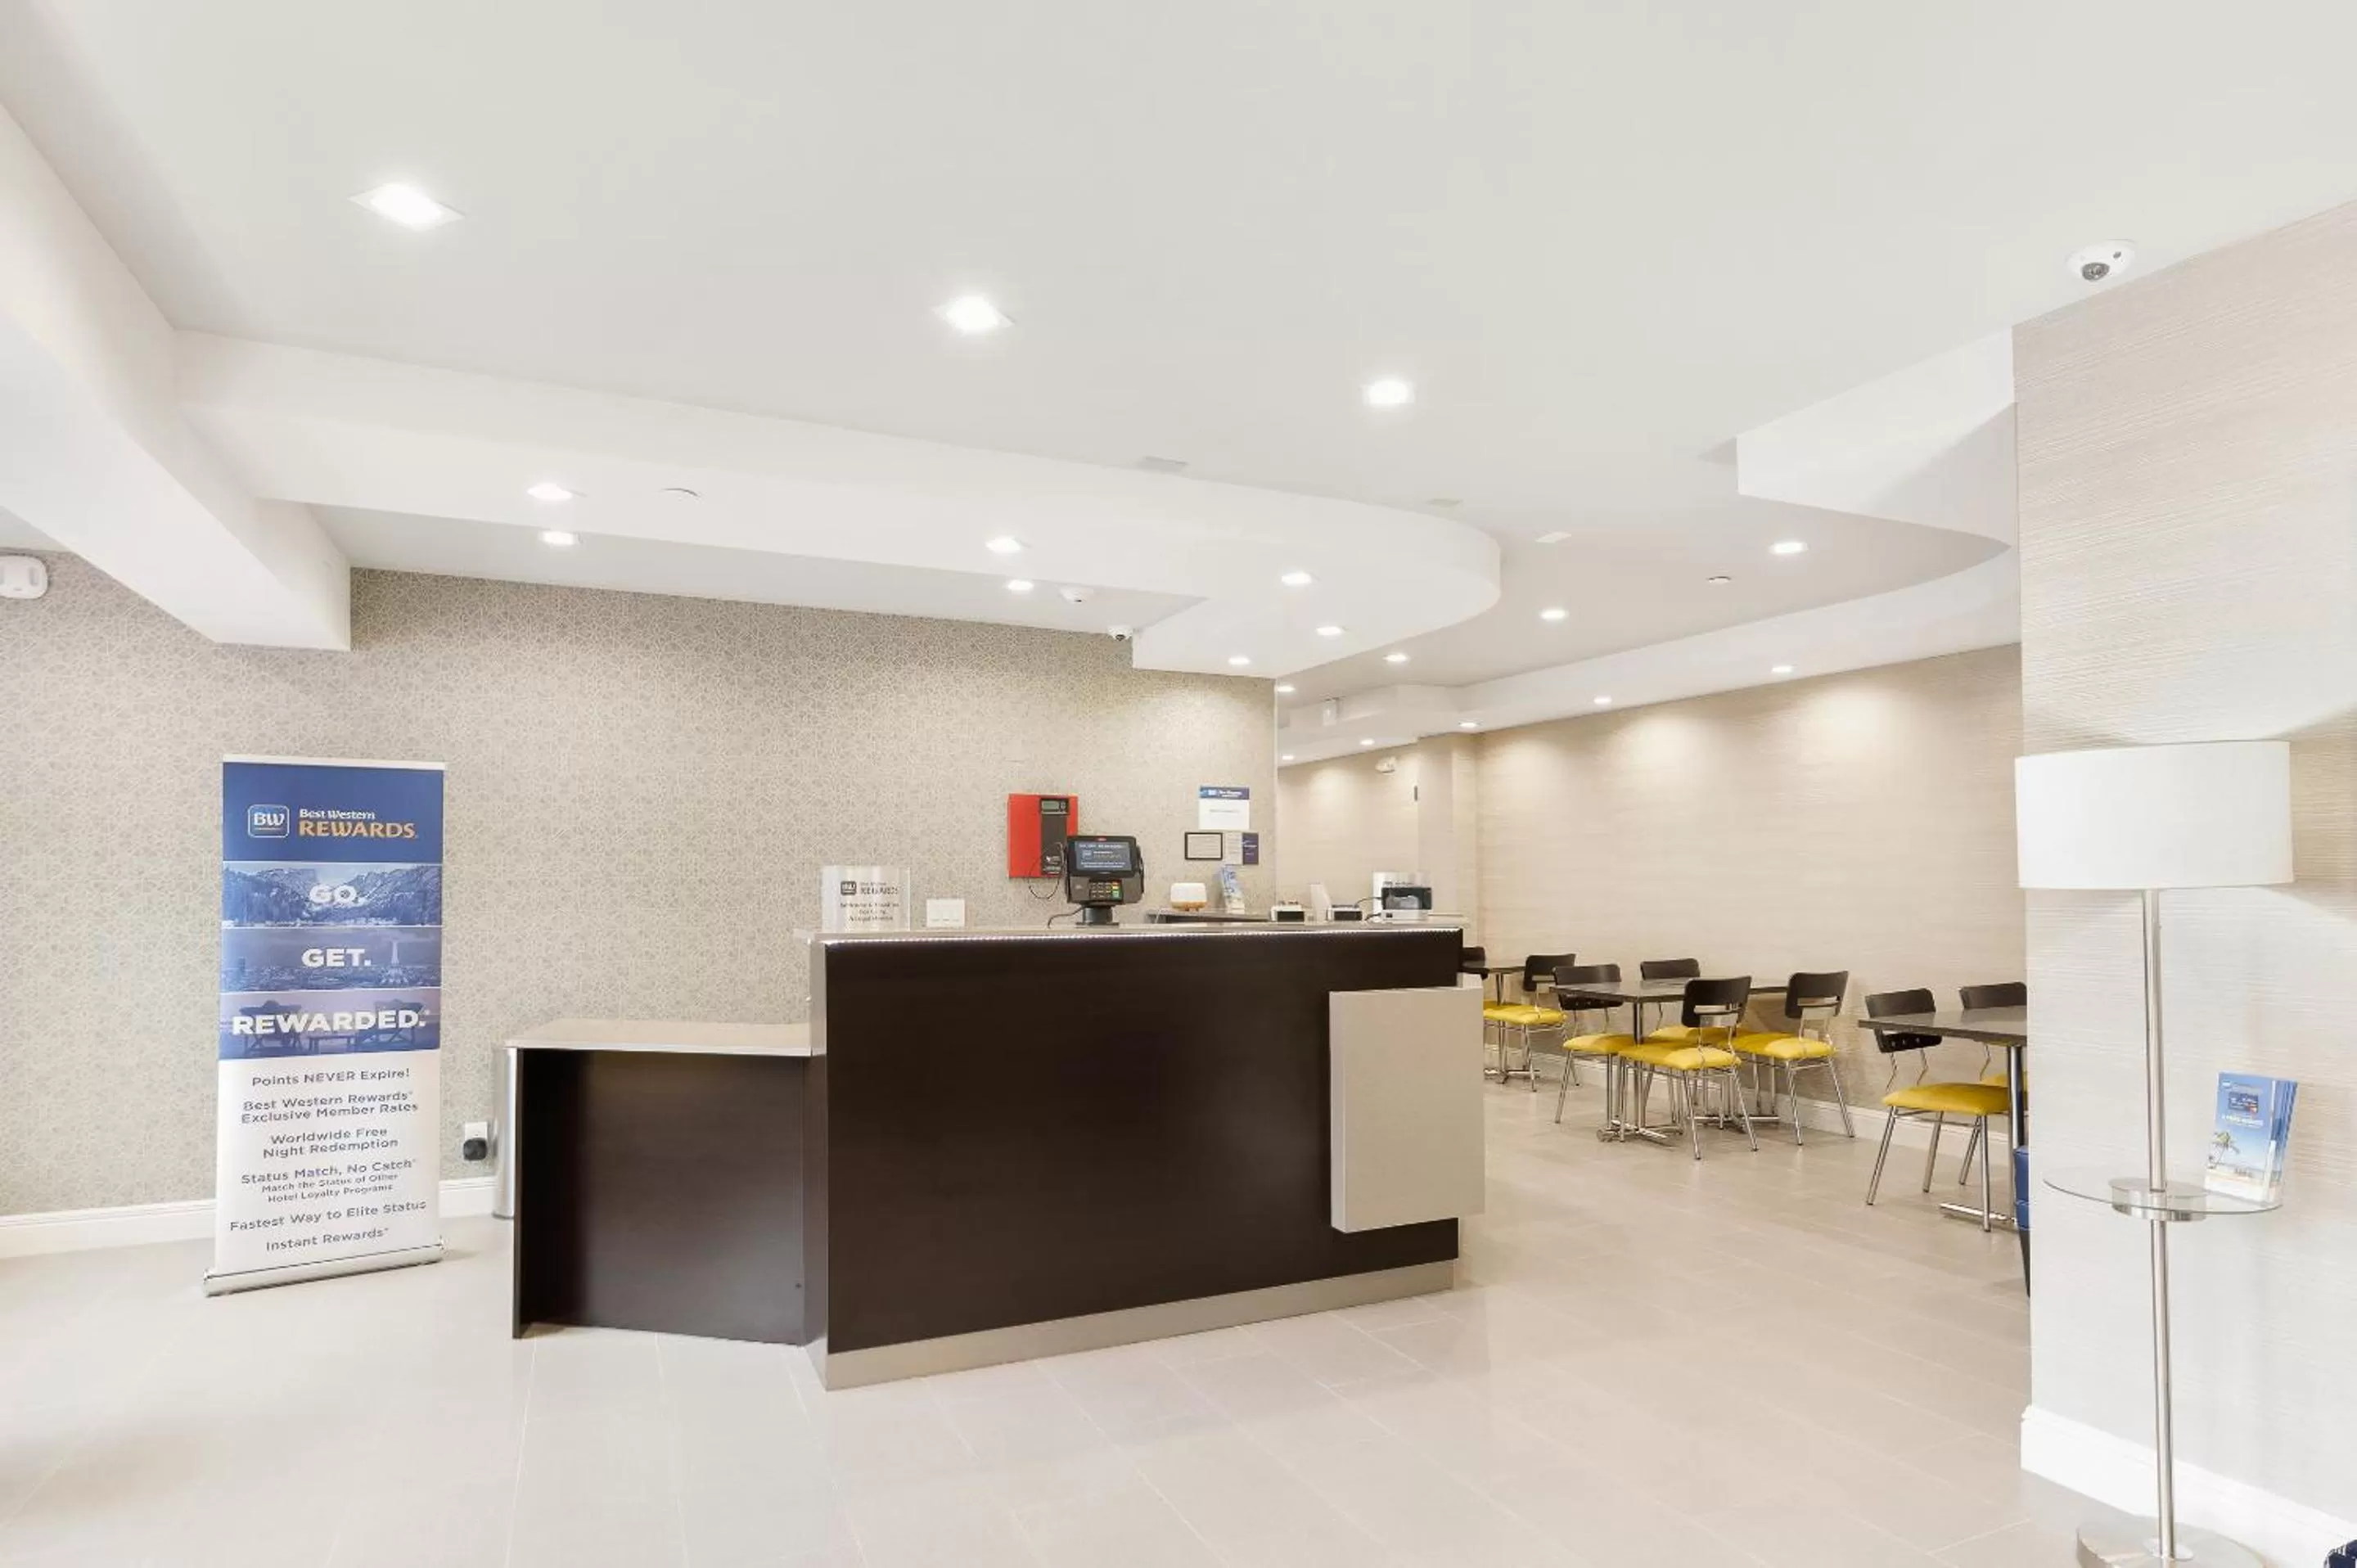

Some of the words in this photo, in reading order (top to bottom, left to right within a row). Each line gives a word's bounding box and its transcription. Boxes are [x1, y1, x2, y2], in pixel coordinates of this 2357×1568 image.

[254, 812, 284, 826] BW
[300, 809, 325, 818] Best
[327, 810, 375, 820] Western
[299, 821, 416, 838] REWARDS
[302, 948, 372, 968] GET.
[252, 1075, 299, 1087] Points
[304, 1071, 354, 1084] NEVER
[361, 1068, 409, 1081] Expire!
[244, 1099, 277, 1111] Best
[282, 1096, 343, 1108] Western
[241, 1111, 310, 1124] Exclusive
[317, 1106, 375, 1118] Member
[380, 1103, 418, 1114] Rates
[271, 1129, 351, 1145] Worldwide
[356, 1128, 387, 1138] Free
[263, 1146, 304, 1159] Night
[309, 1138, 399, 1155] Redemption
[241, 1171, 288, 1184] Status
[347, 1164, 367, 1173] No
[262, 1183, 295, 1193] Match
[319, 1178, 352, 1187] Status
[369, 1174, 399, 1182] Other
[268, 1193, 298, 1203] Hotel
[301, 1189, 340, 1201] Loyalty
[344, 1185, 393, 1196] Programs
[230, 1218, 285, 1231] Fastest
[291, 1214, 322, 1224] Way
[327, 1210, 342, 1219] to
[347, 1205, 378, 1217] Elite
[383, 1201, 426, 1214] Status
[267, 1237, 318, 1251] Instant
